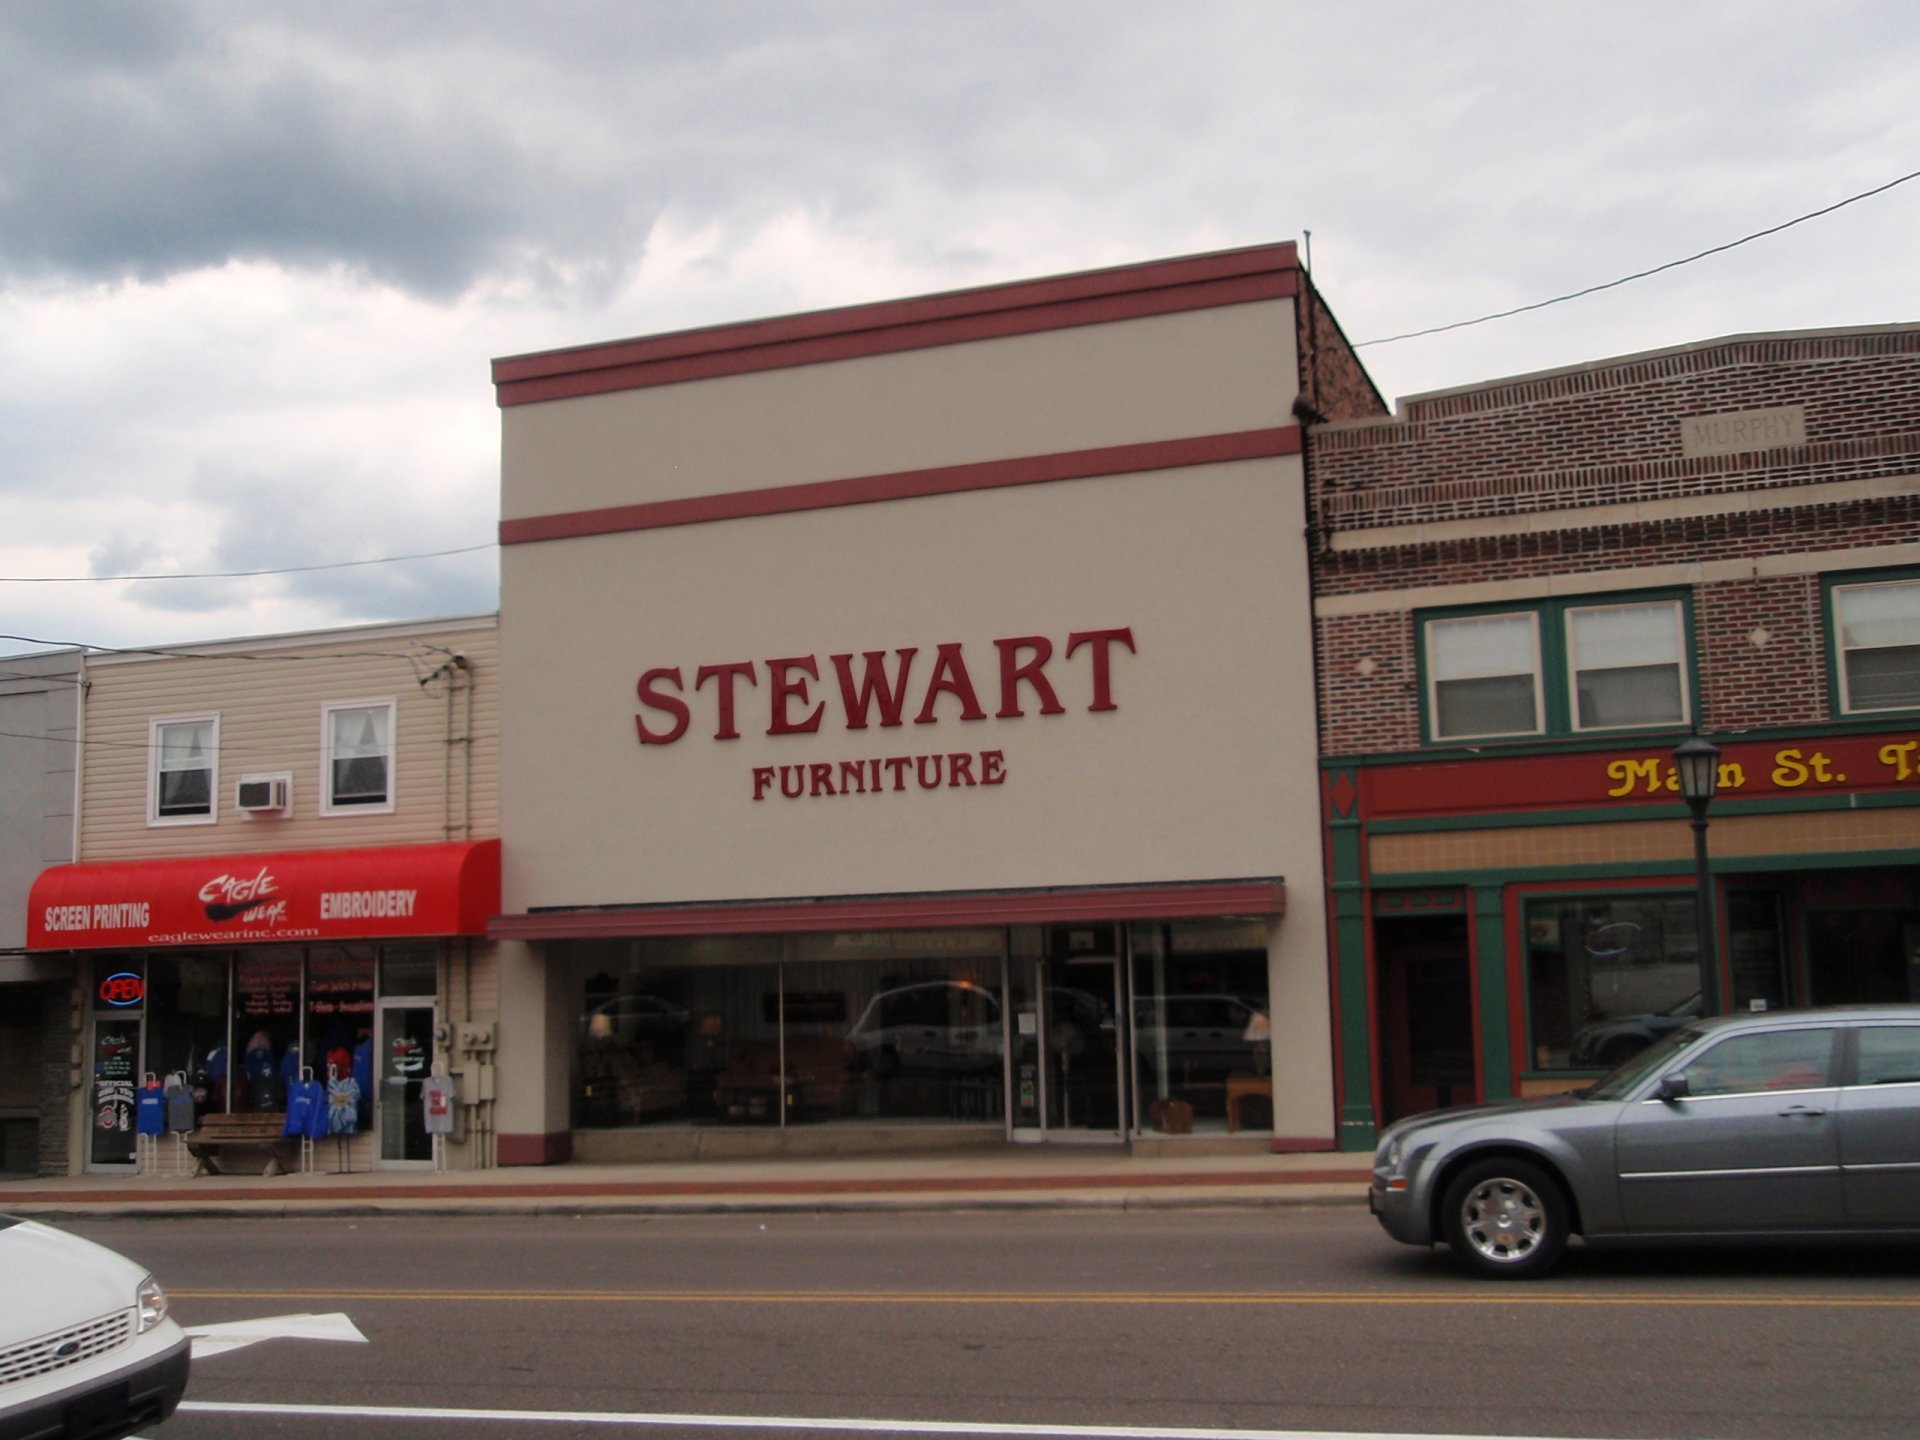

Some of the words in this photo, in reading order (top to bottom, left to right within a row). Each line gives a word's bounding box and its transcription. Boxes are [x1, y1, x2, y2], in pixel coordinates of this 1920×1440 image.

[1693, 412, 1795, 447] MURPHY
[634, 627, 1137, 745] STEWART
[752, 750, 1007, 800] FURNITURE
[1607, 758, 1746, 797] Man
[1771, 749, 1847, 788] St.
[1878, 741, 1920, 780] T
[45, 905, 91, 931] SCREEN
[93, 902, 150, 929] PRINTING
[320, 890, 418, 919] EMBROIDERY
[148, 928, 319, 944] eaglewearinc.com
[100, 978, 145, 1001] OPEN
